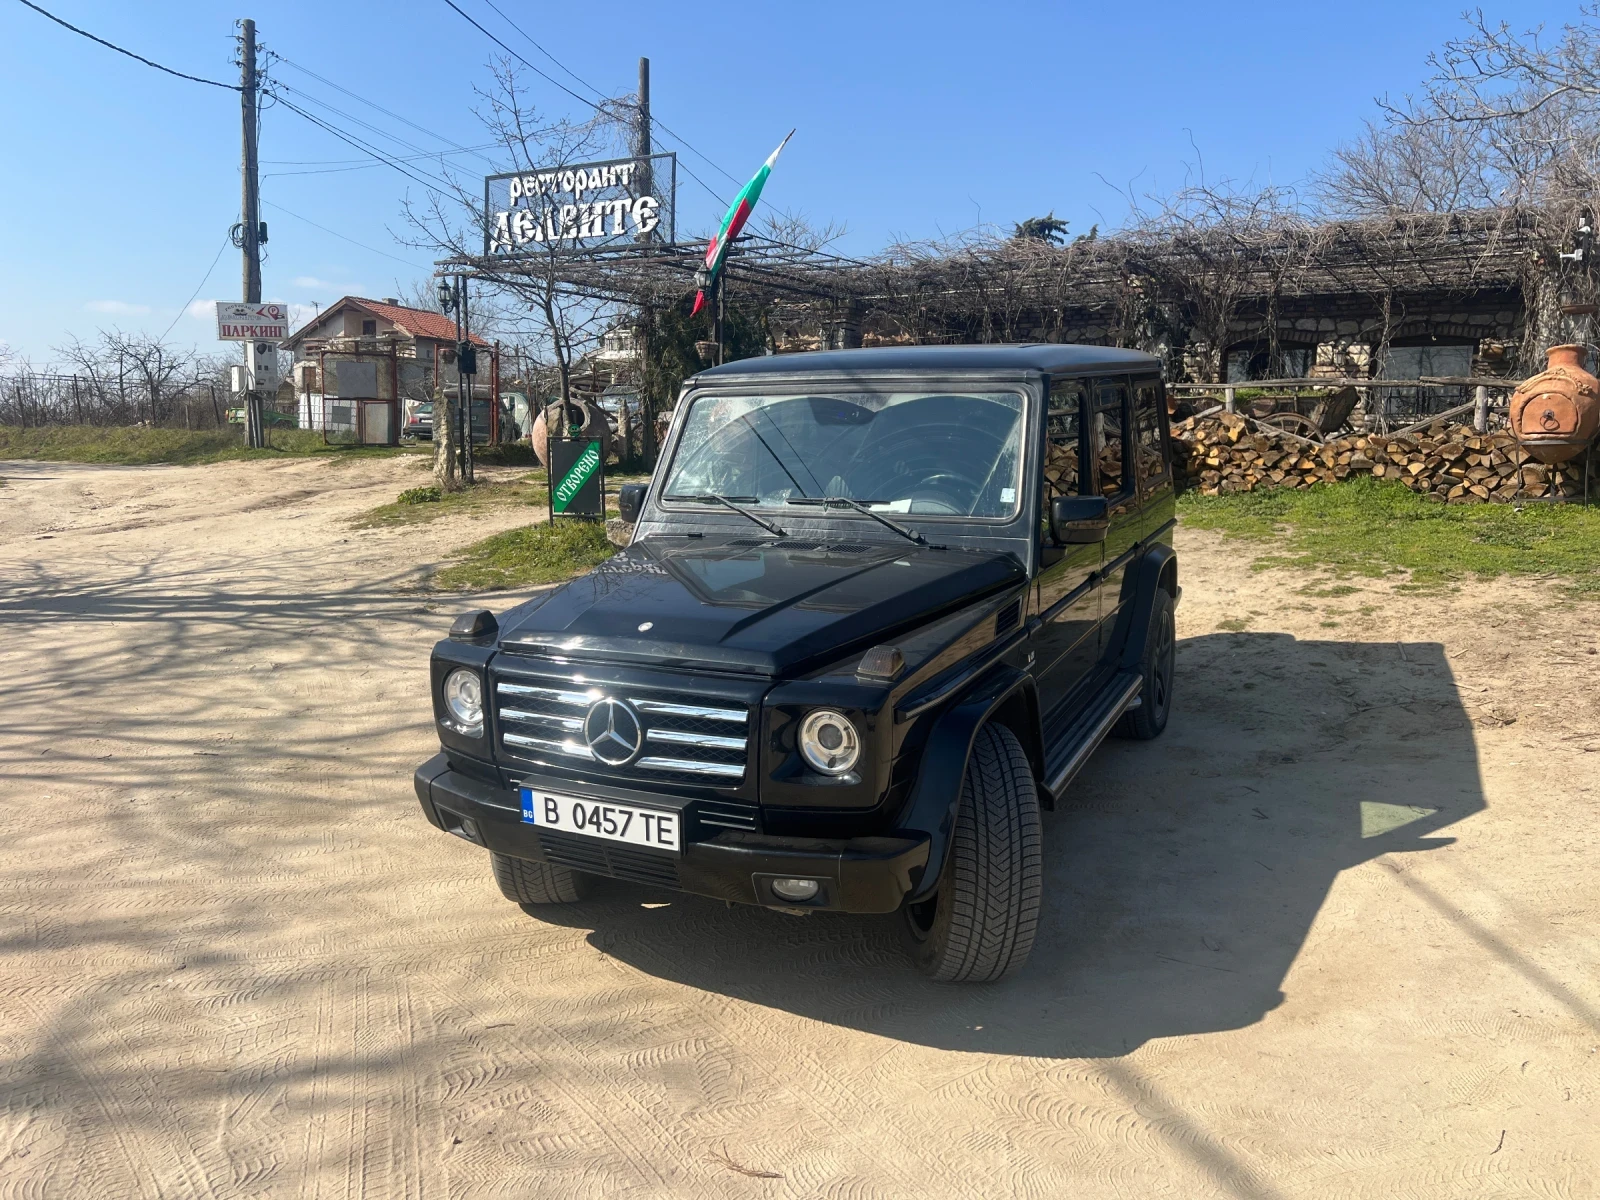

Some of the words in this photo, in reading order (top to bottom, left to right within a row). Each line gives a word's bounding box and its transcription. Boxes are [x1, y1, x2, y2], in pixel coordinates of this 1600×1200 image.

[222, 325, 286, 338] ПАРКИНГ
[556, 449, 599, 502] ОТВОРЕНО
[523, 809, 533, 819] BG
[544, 797, 560, 824] B
[572, 802, 633, 837] 0457
[639, 813, 674, 845] TE
